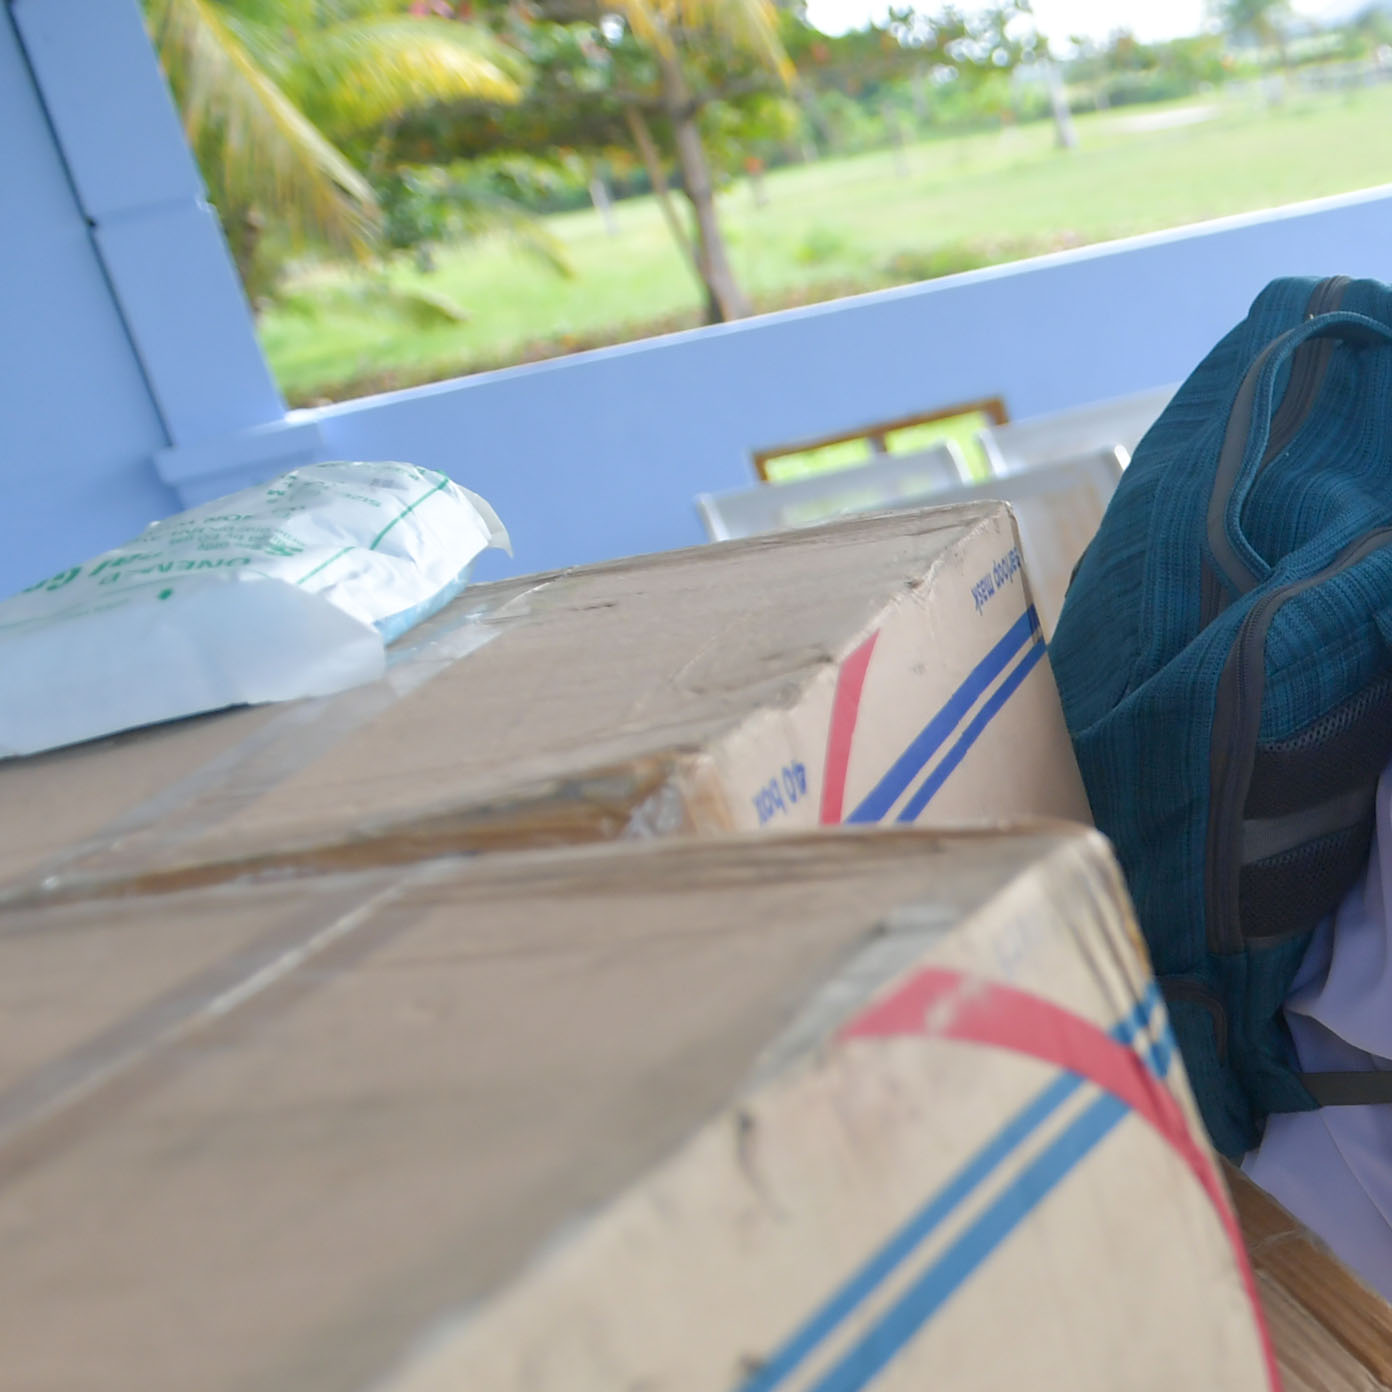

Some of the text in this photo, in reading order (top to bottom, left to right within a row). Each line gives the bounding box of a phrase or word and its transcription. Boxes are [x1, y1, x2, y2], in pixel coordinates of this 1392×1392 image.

[970, 574, 994, 615] mask
[754, 760, 807, 826] 40 box
